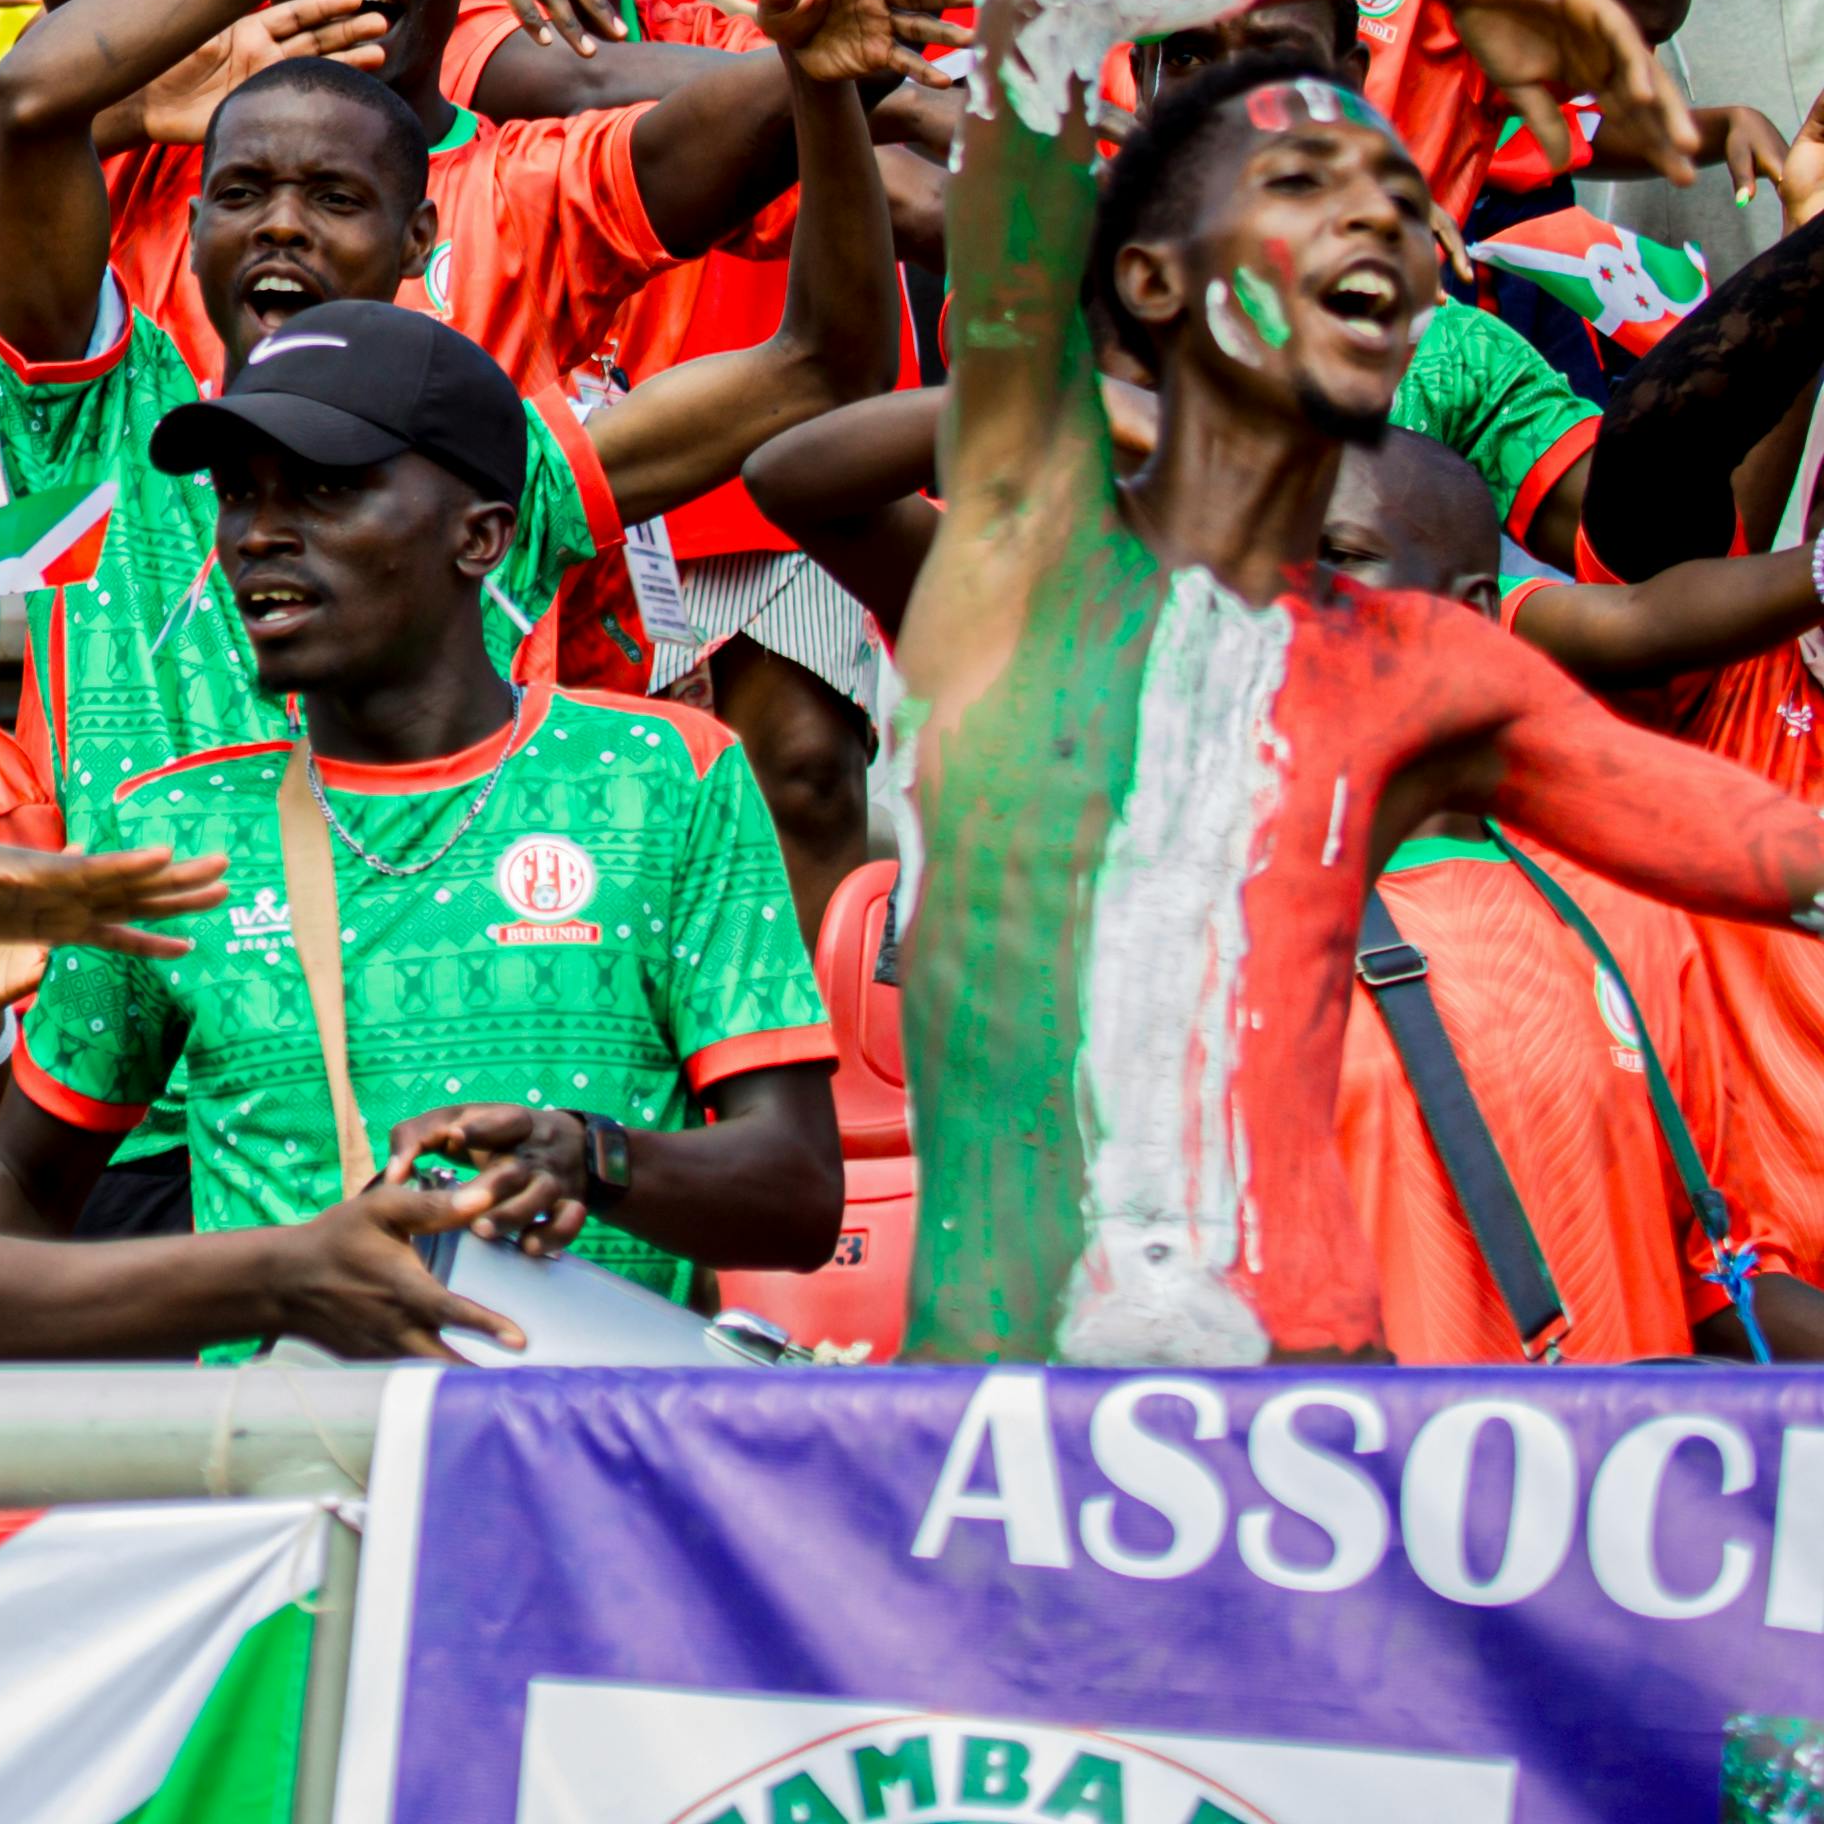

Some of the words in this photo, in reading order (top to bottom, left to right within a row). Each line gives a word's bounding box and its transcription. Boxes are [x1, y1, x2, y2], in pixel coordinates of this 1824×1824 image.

[512, 843, 586, 908] FFB
[505, 925, 591, 944] BURUNDI
[697, 1733, 1124, 1824] AMBA
